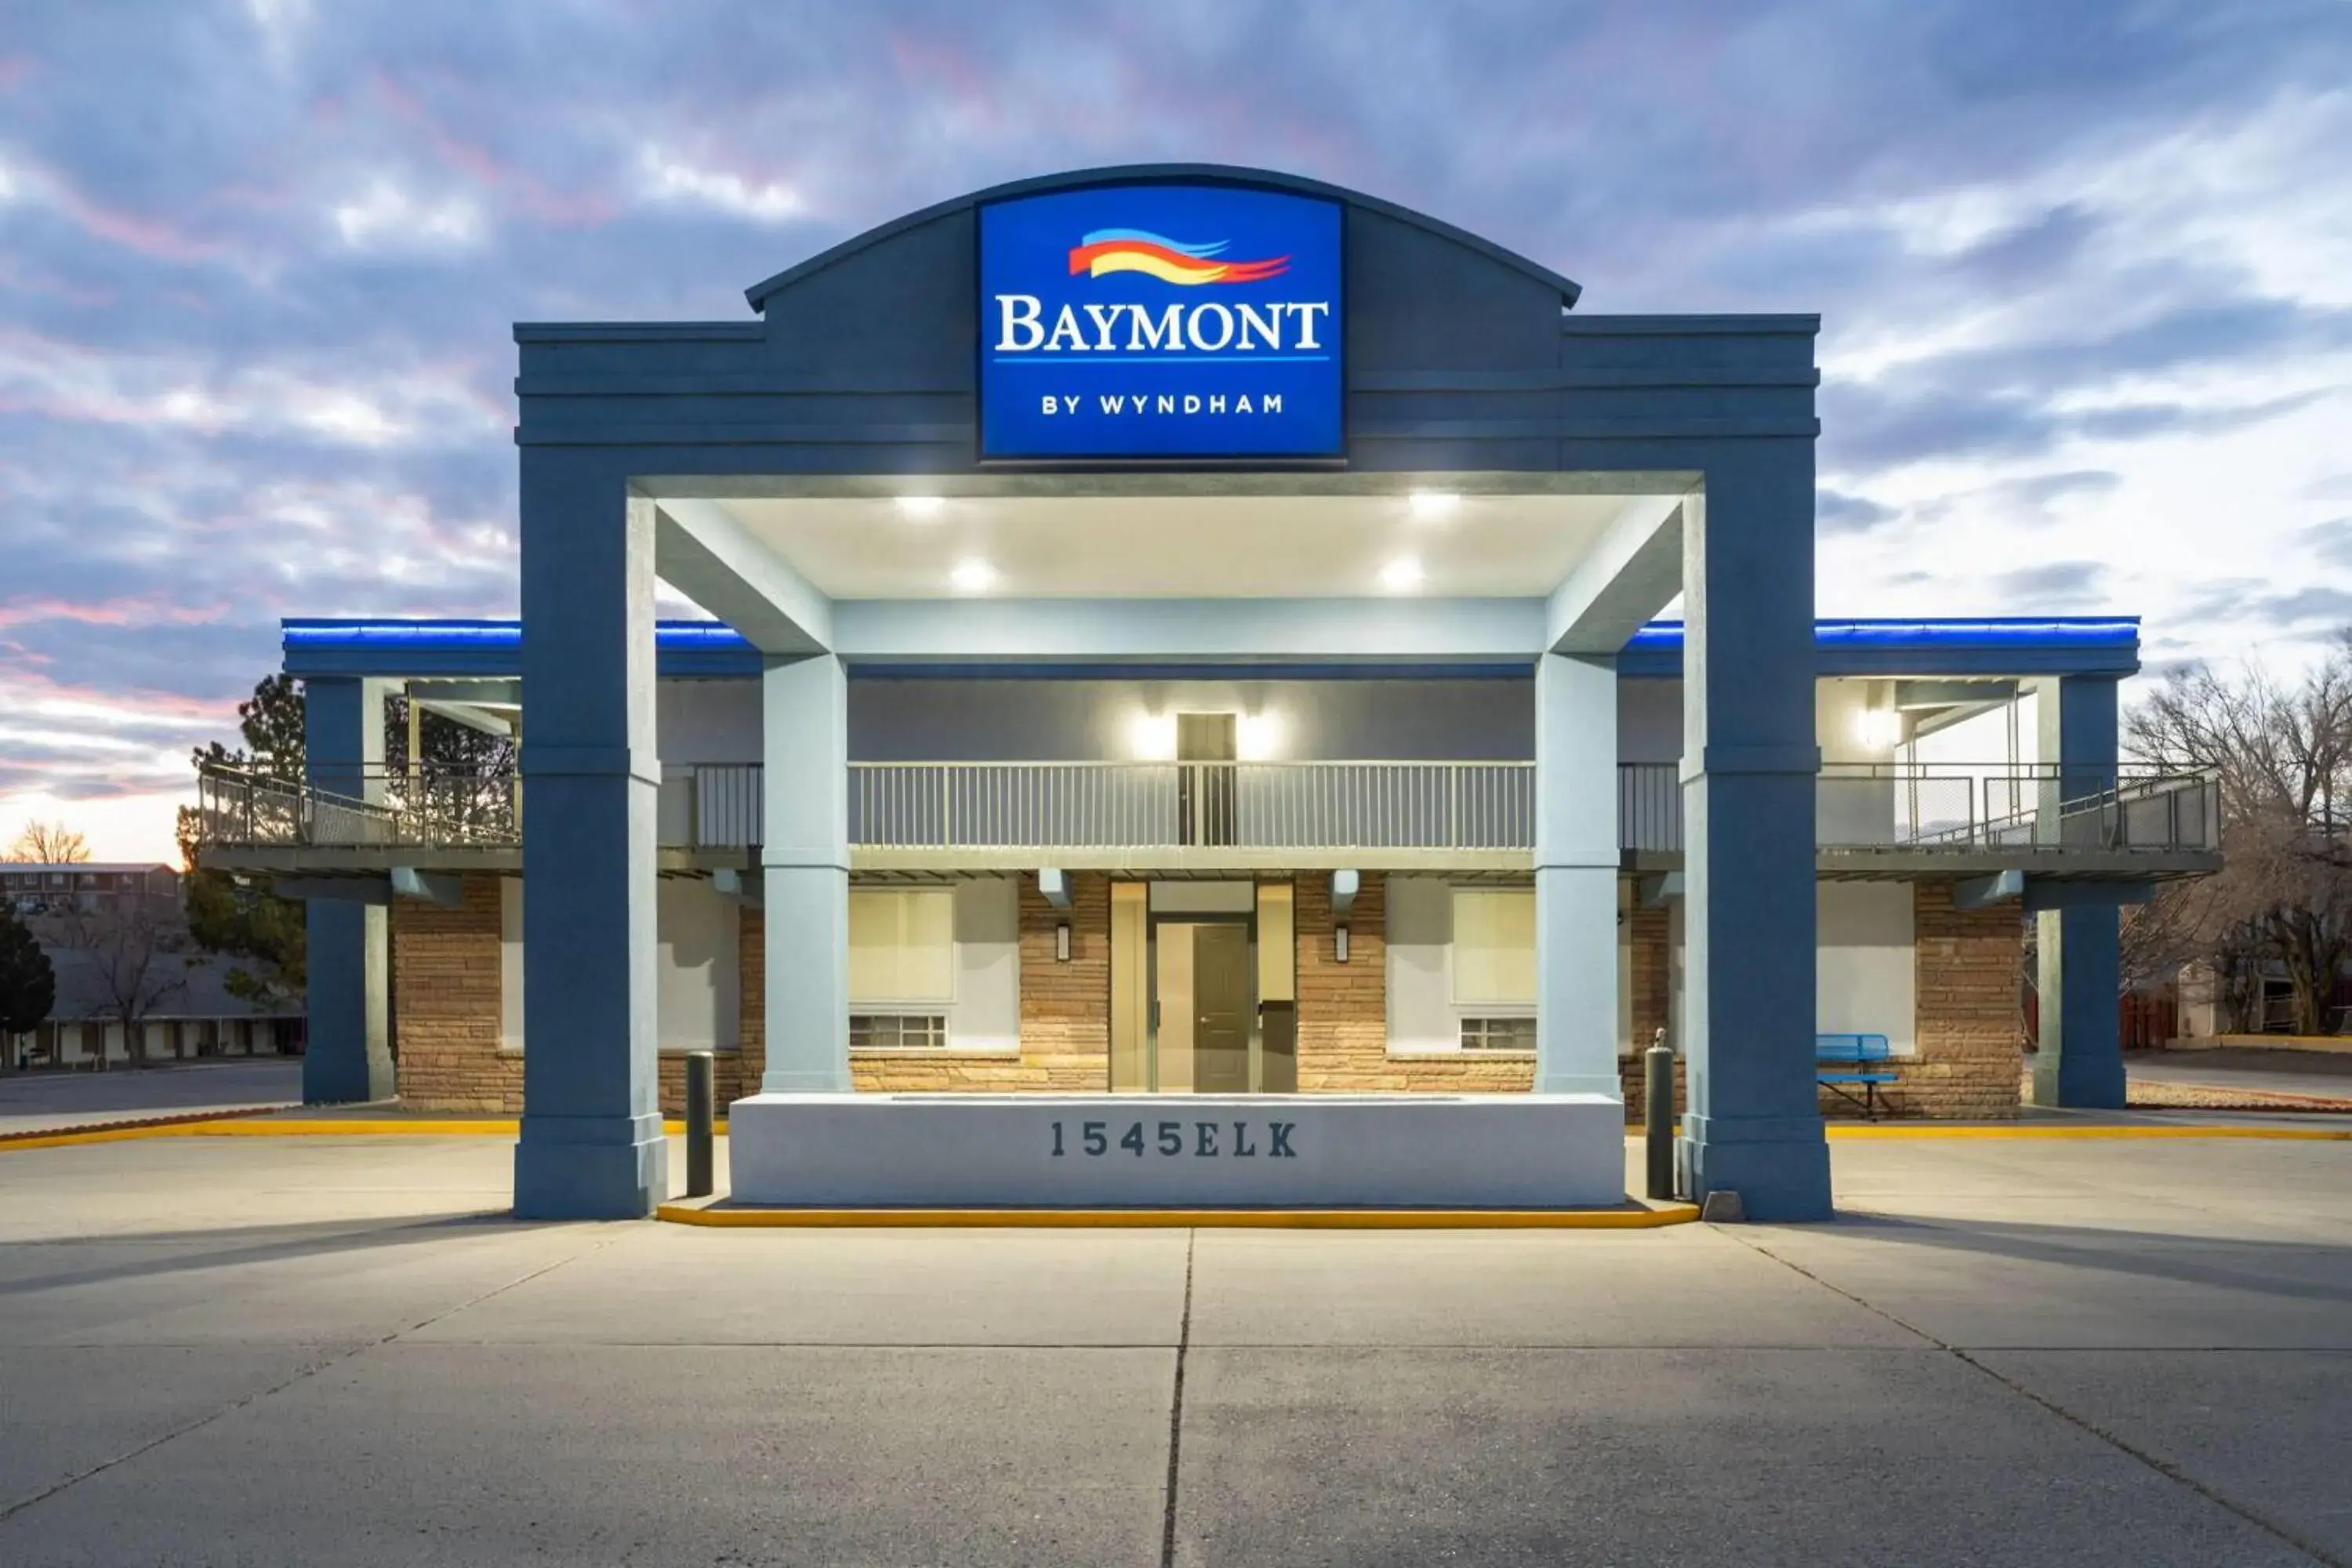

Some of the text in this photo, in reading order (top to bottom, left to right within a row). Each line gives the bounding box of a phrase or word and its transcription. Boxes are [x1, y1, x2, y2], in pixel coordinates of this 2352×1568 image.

[994, 294, 1330, 351] BAYMONT
[1041, 394, 1284, 415] BY WYNDHAM
